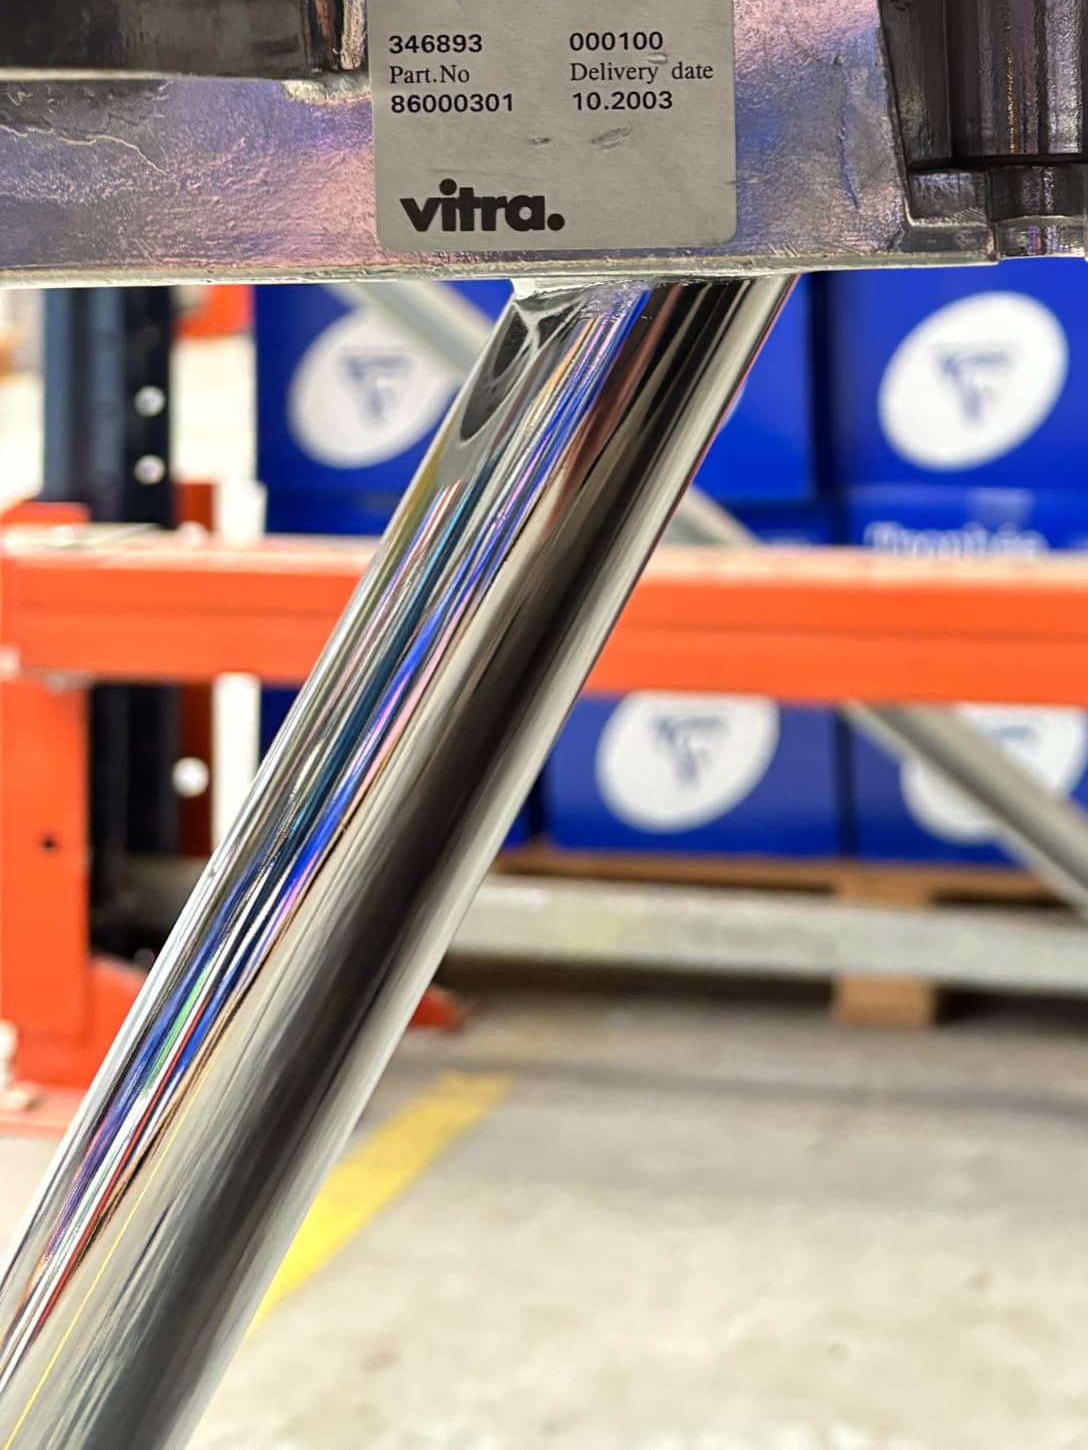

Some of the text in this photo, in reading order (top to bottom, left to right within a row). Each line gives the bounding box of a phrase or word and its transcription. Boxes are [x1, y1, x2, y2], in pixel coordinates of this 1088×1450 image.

[388, 33, 483, 54] 346893
[569, 31, 664, 52] 000100
[389, 64, 470, 84] Part.No
[570, 61, 714, 85] Delivery date
[391, 93, 514, 114] 86000301
[572, 90, 673, 111] 10.2003
